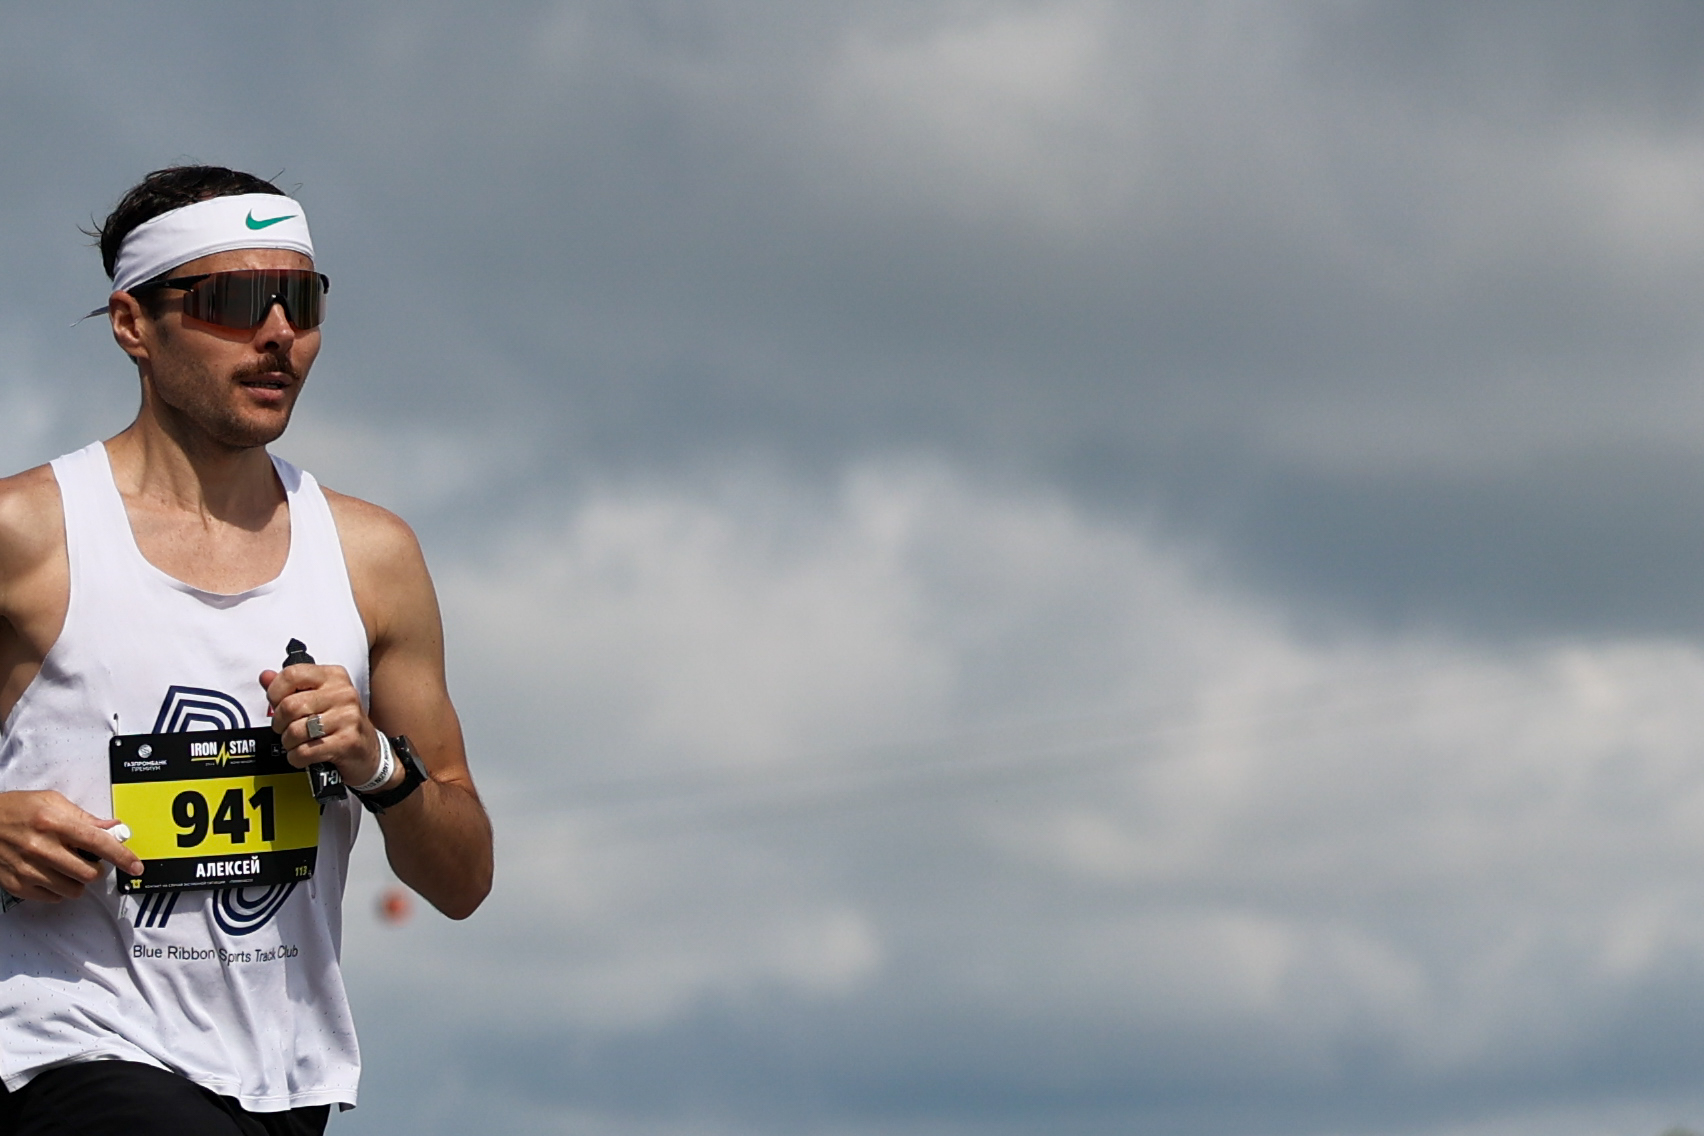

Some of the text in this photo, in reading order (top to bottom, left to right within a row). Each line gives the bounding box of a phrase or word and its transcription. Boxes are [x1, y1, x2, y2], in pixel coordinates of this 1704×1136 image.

[190, 739, 256, 757] IRON STAR
[172, 787, 275, 848] 941
[196, 856, 261, 879] АЛЕКСЕЙ
[133, 945, 163, 959] Blue
[167, 945, 216, 960] Ribbon
[255, 947, 276, 962] Track
[277, 944, 299, 959] Club
